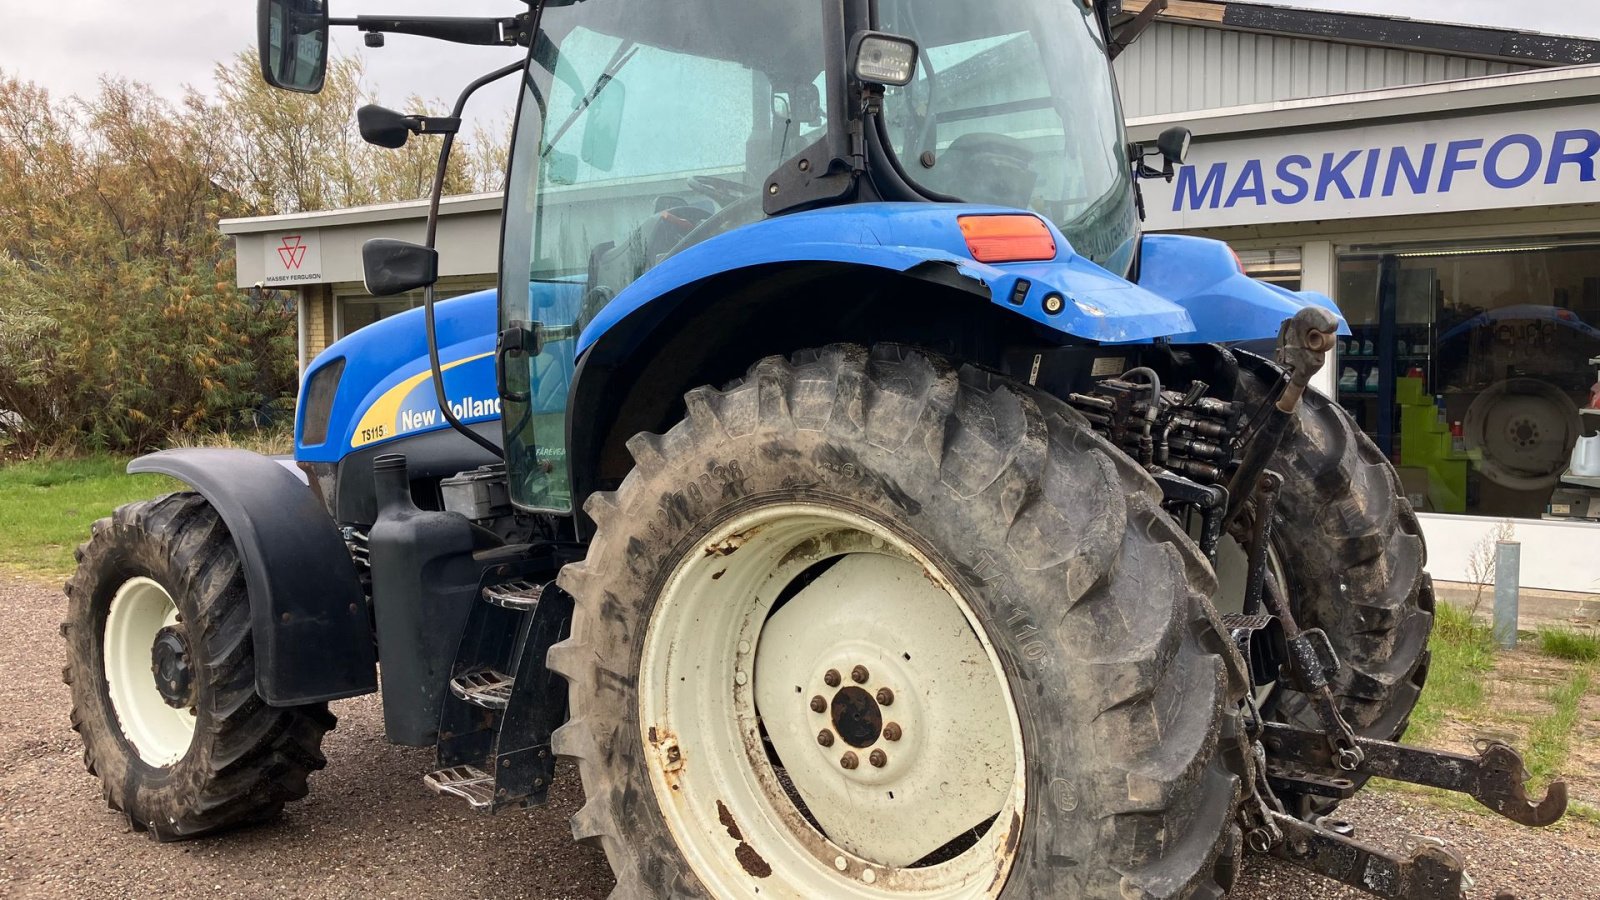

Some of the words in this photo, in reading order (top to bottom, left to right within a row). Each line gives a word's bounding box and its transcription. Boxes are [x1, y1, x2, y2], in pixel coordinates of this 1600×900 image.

[1172, 129, 1600, 212] MASKINFOR
[290, 273, 321, 281] FERGUSON
[402, 409, 436, 431] New
